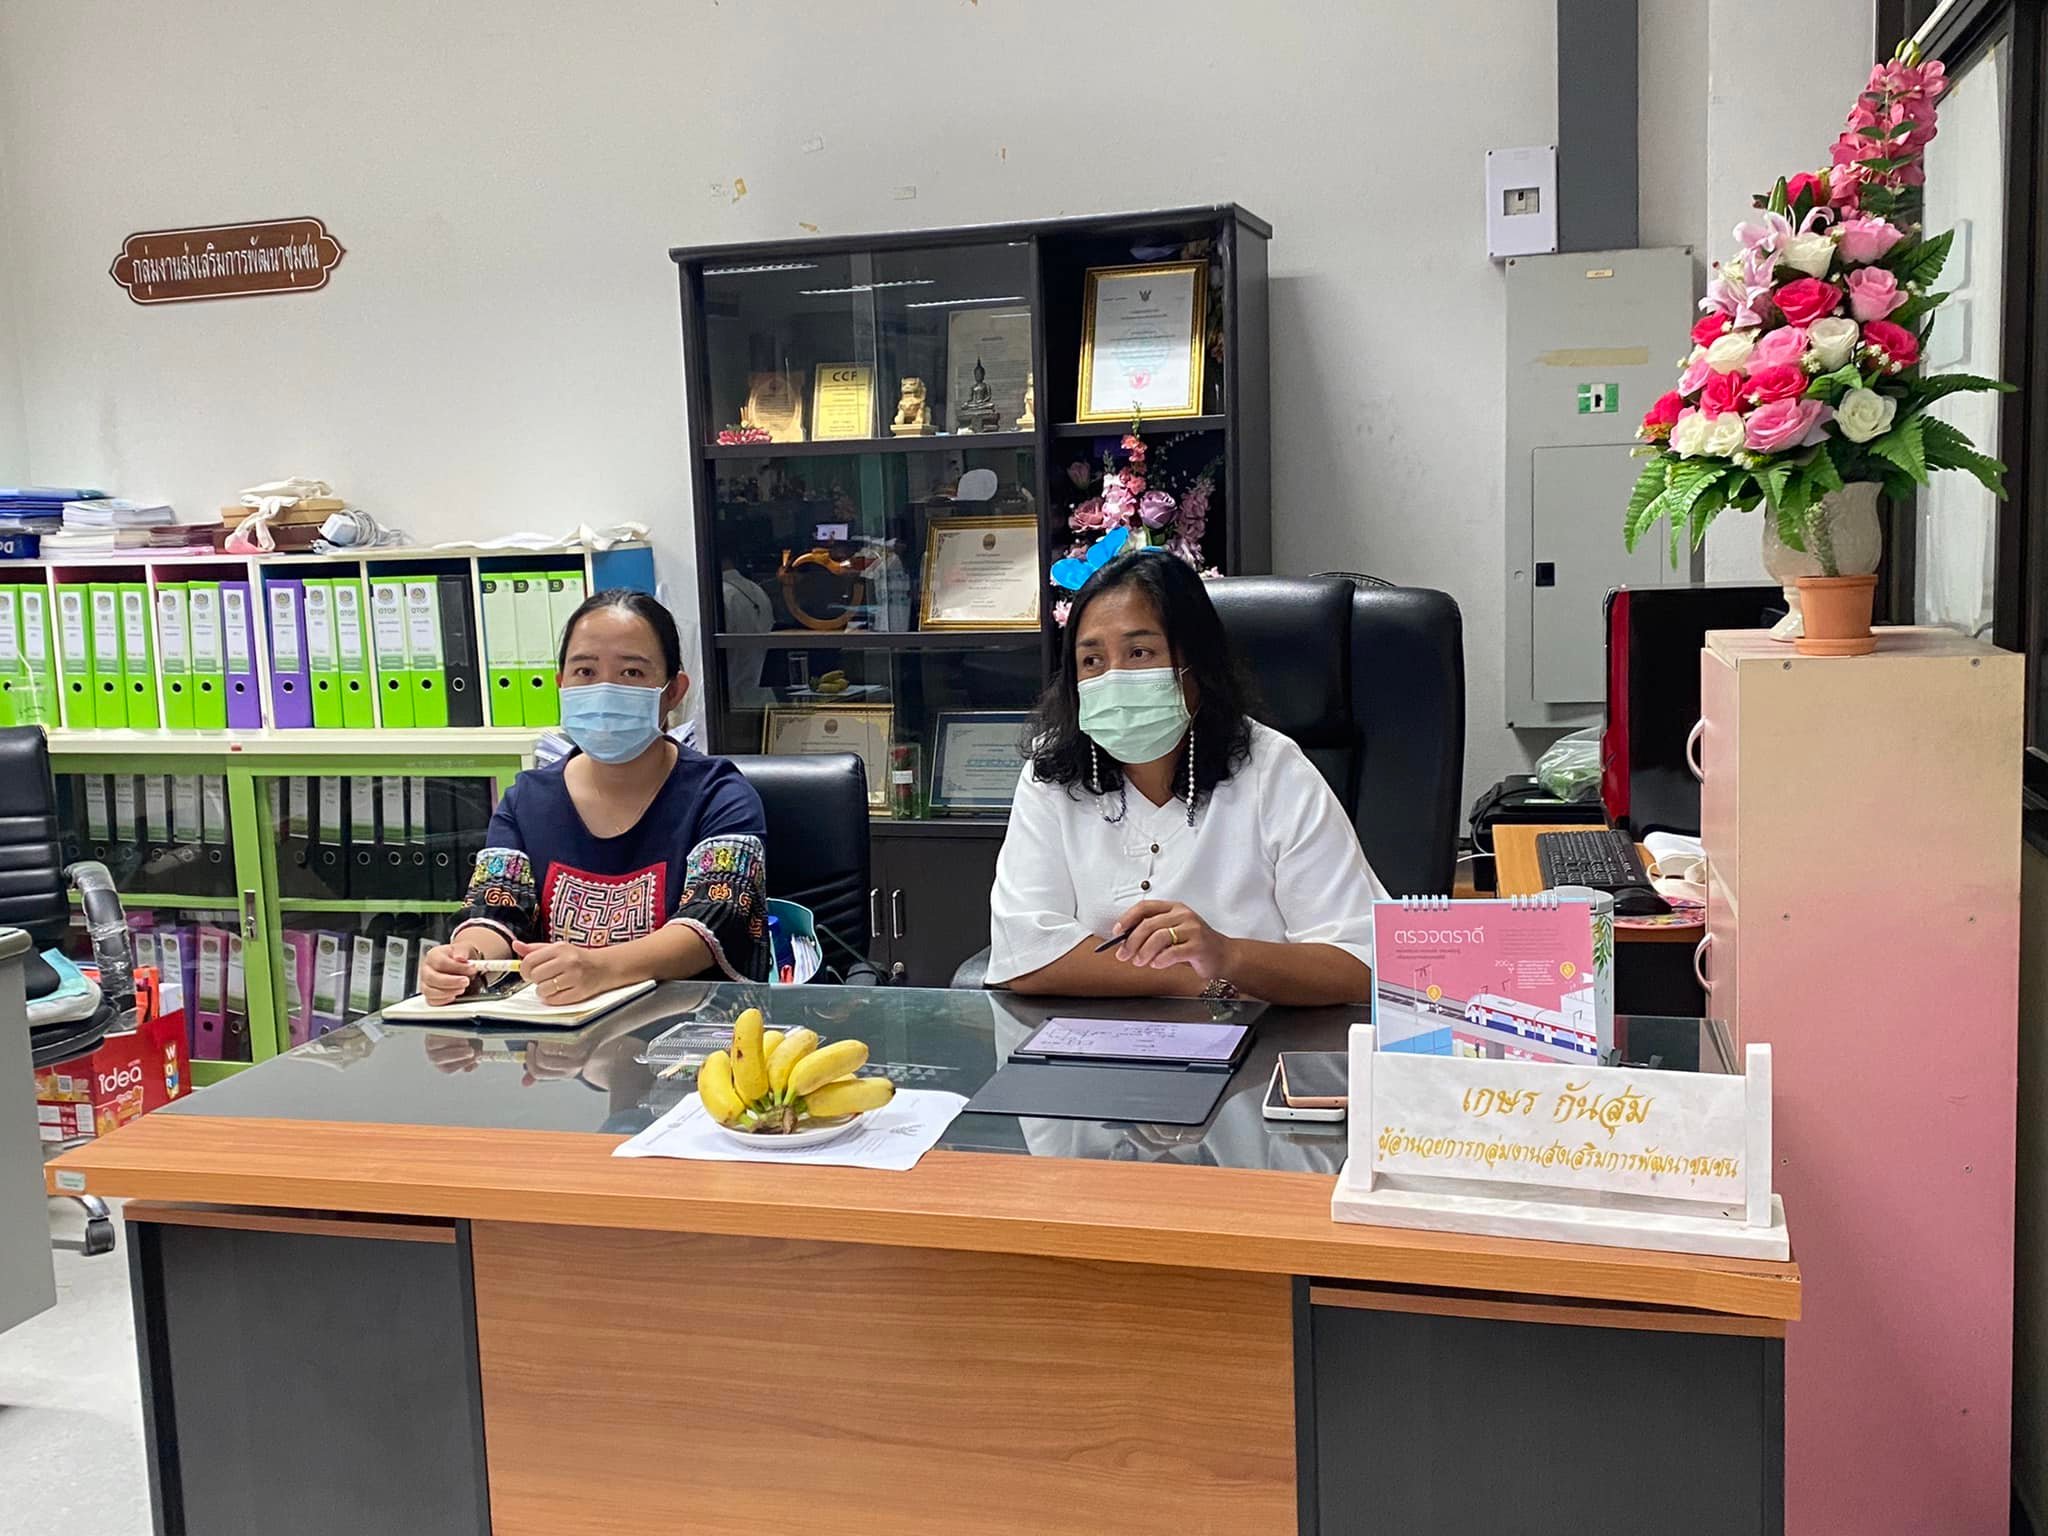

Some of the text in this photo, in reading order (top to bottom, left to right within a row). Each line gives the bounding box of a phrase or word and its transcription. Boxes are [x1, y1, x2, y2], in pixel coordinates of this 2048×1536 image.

[132, 233, 319, 295] กลุ่มงานส่งเสริมการพัฒนาชุมชน
[1394, 926, 1485, 944] ตรวจตราดี
[1462, 1088, 1542, 1117] เกษร
